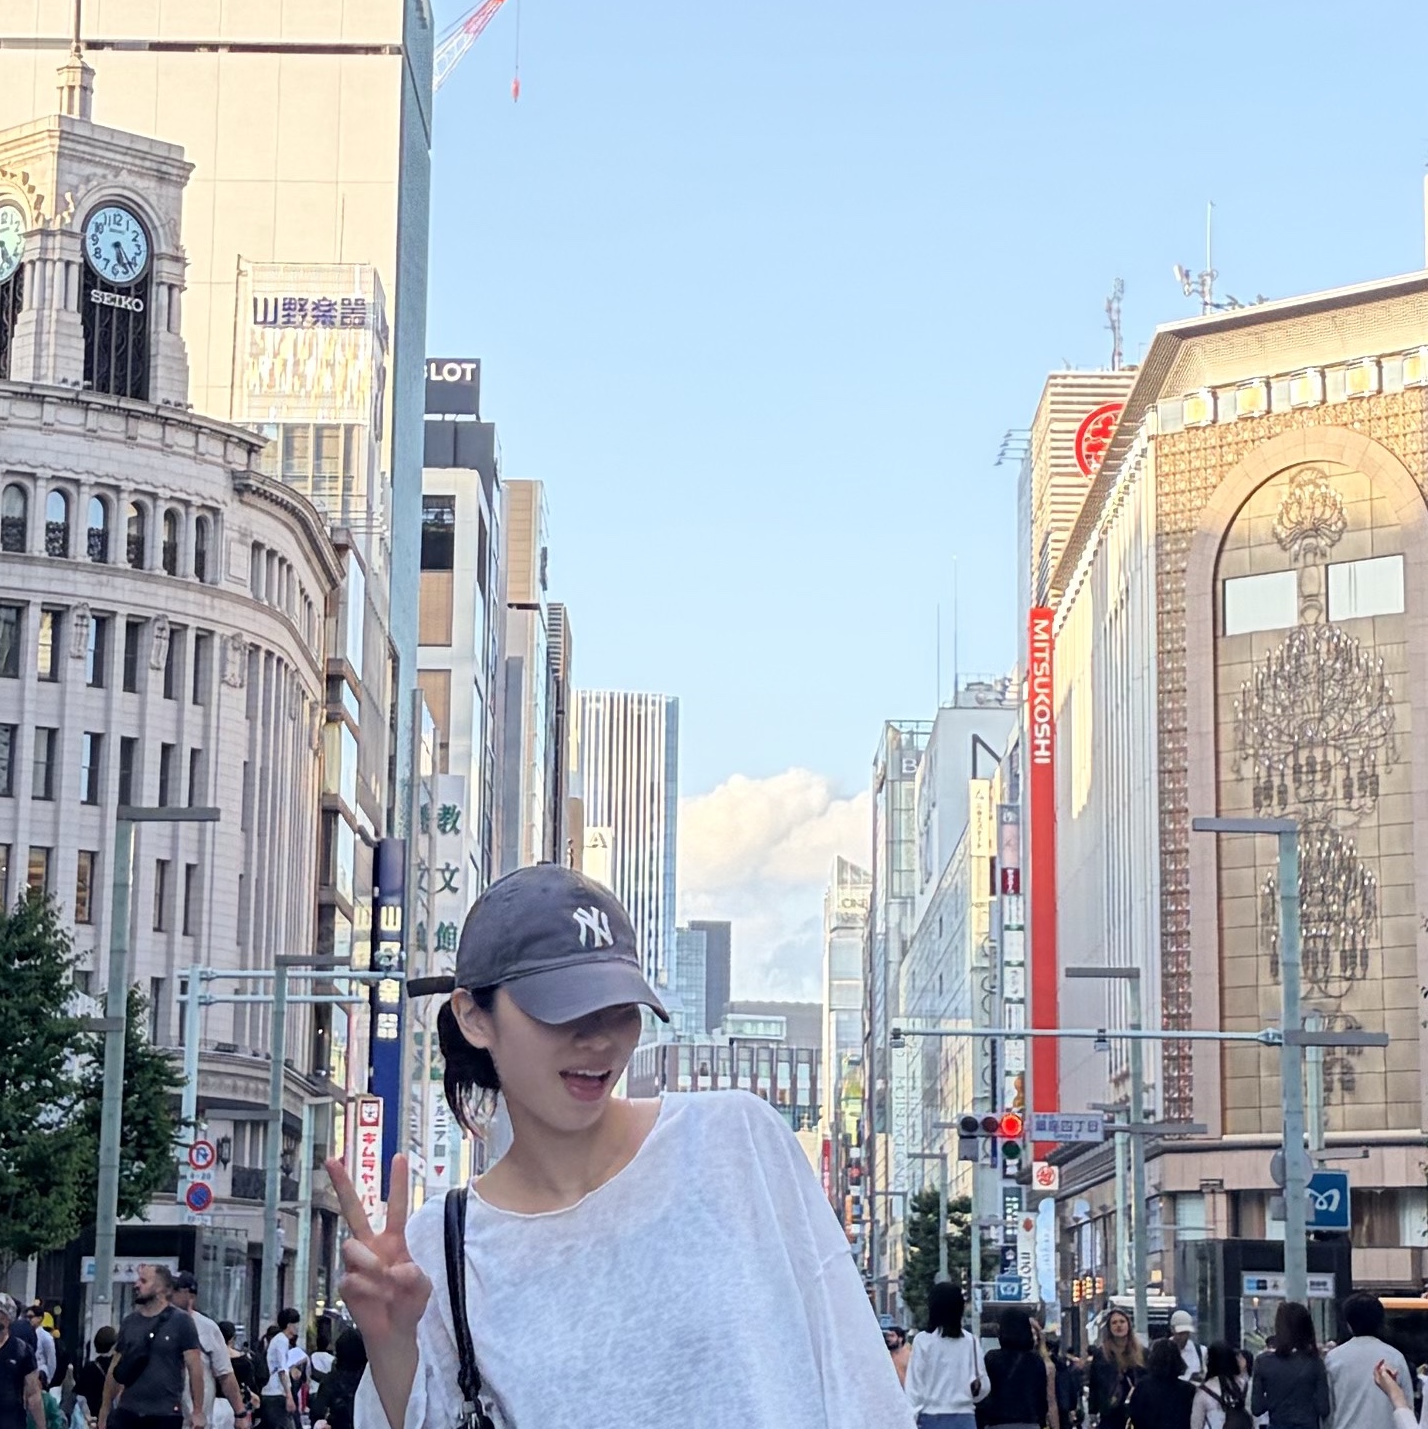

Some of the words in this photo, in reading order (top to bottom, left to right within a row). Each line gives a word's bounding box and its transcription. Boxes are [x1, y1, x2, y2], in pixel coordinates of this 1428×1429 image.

[90, 289, 144, 312] SEIKO
[253, 296, 367, 326] 山野楽器
[1033, 619, 1051, 764] MITSUKOSHI
[434, 803, 462, 953] 教文館
[573, 906, 614, 948] NY
